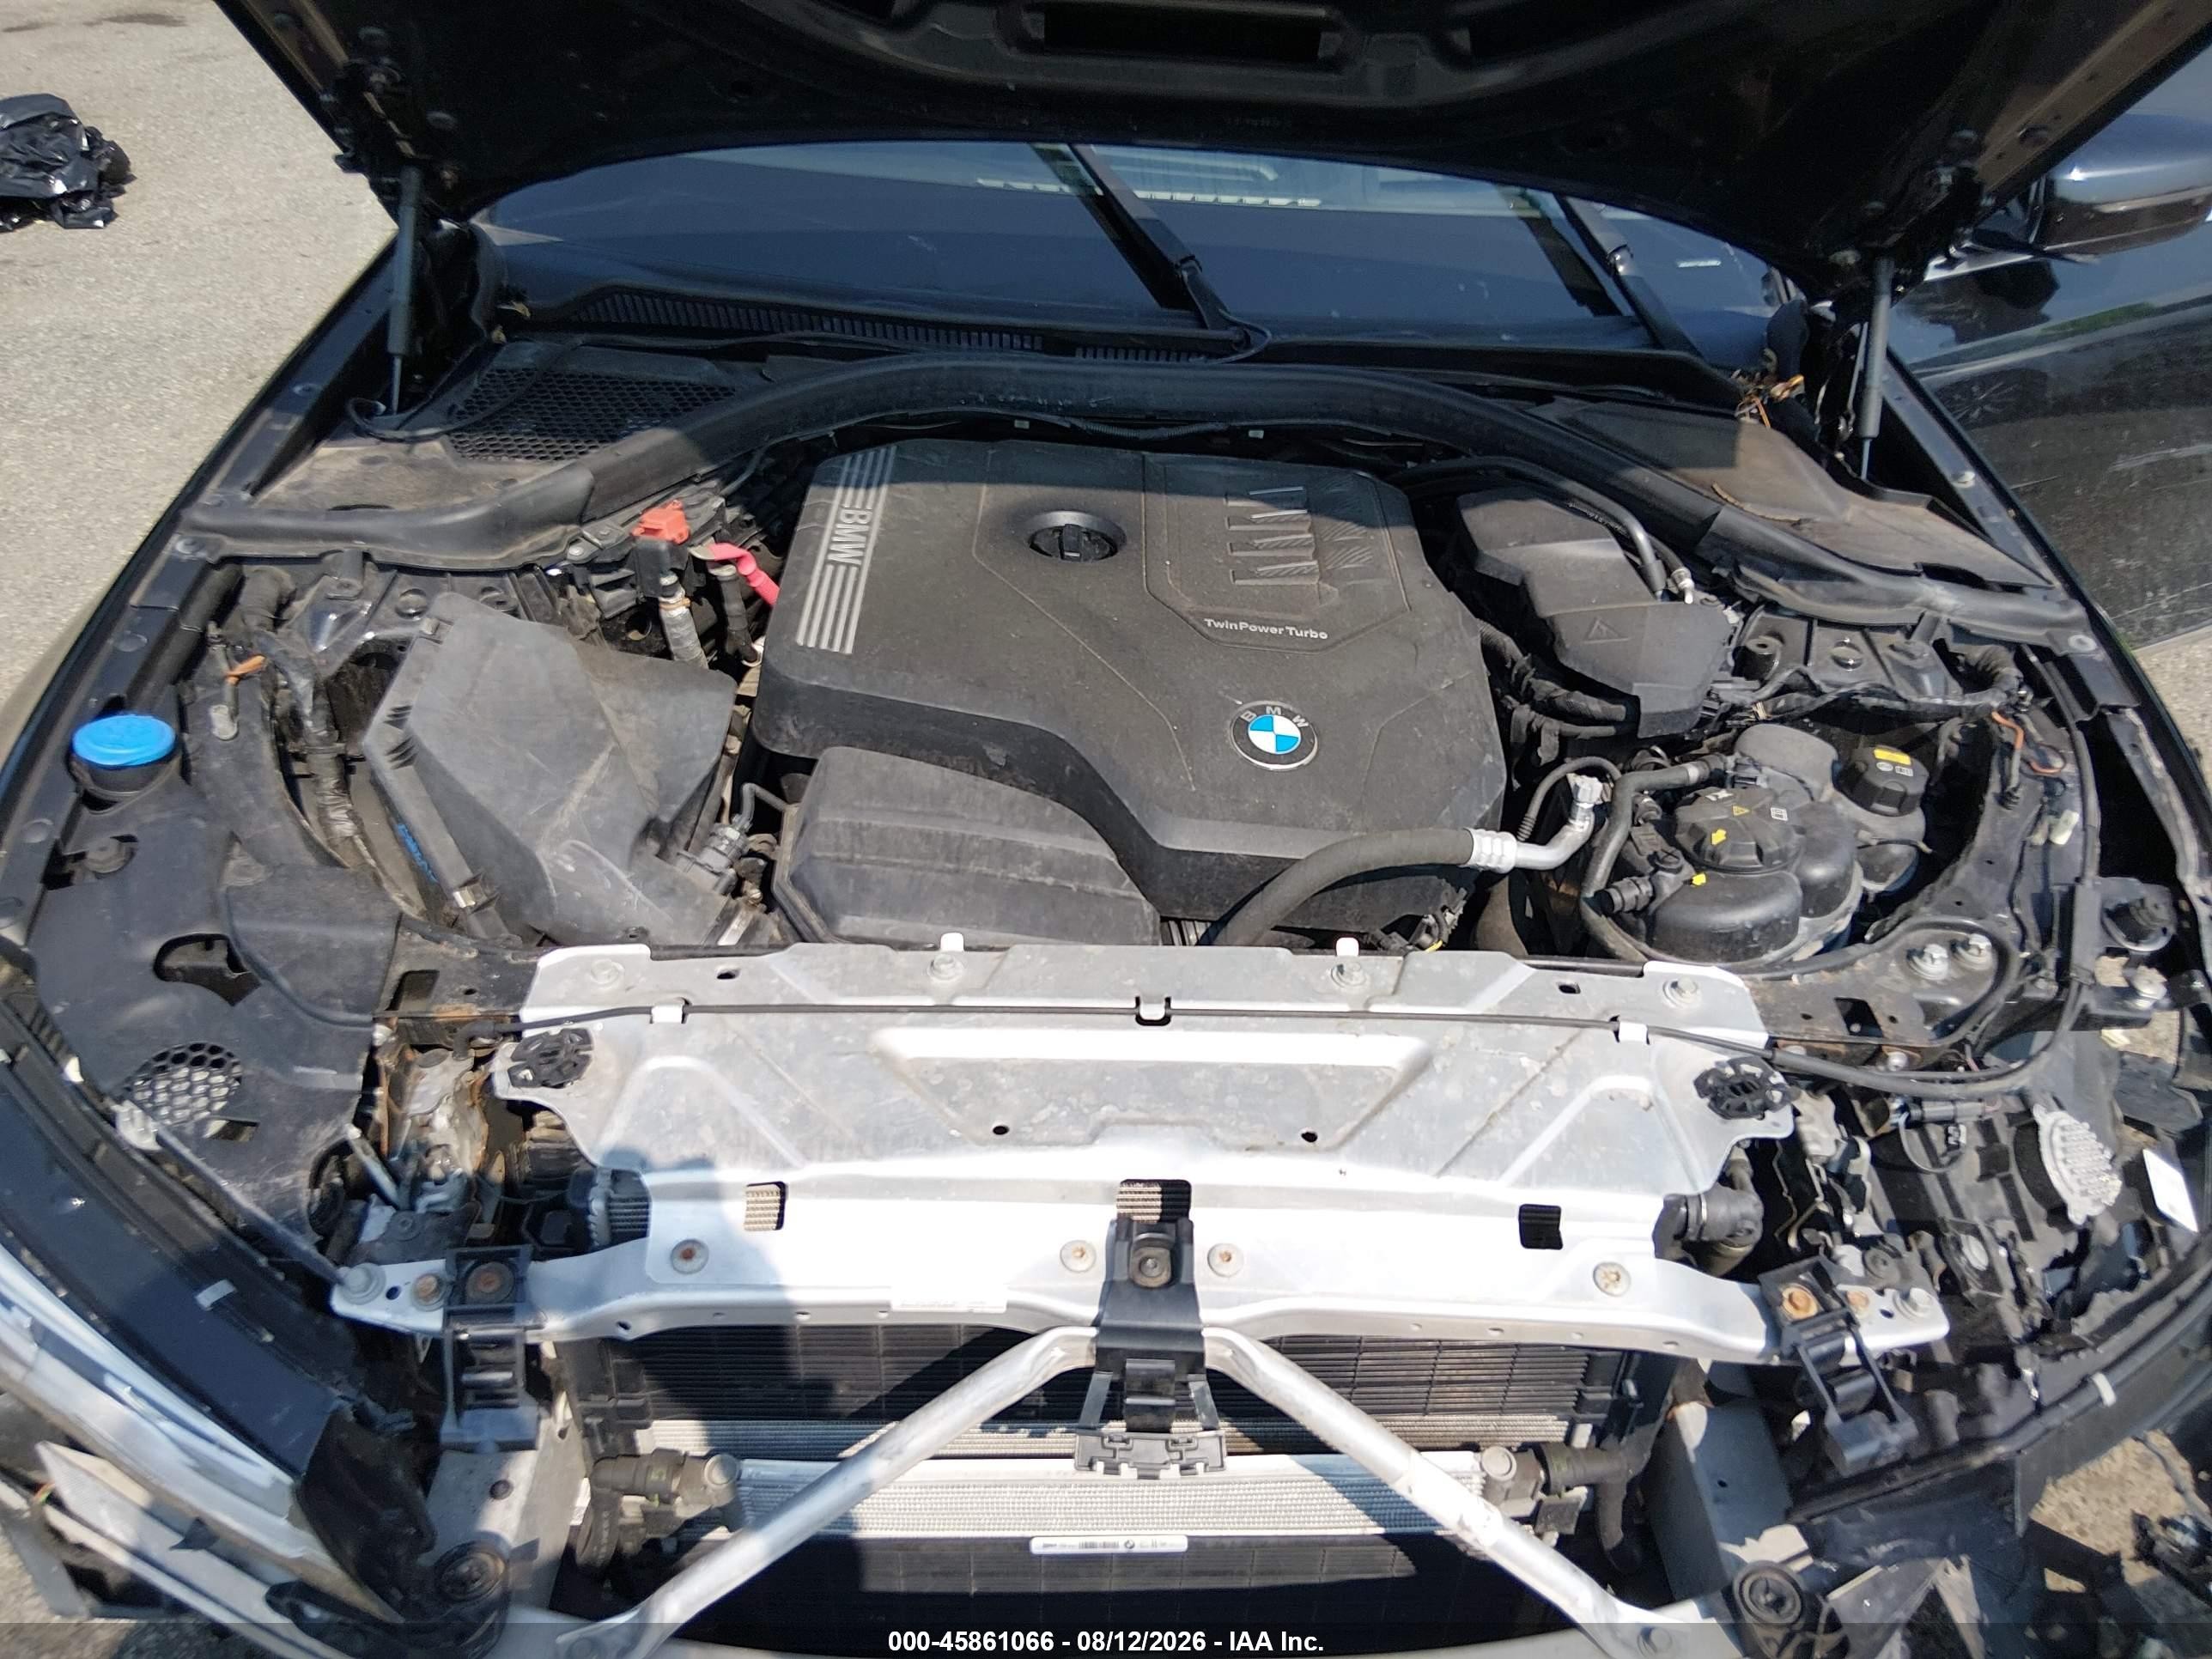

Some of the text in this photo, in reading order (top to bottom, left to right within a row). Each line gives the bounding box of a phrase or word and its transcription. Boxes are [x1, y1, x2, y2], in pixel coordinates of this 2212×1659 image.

[828, 509, 873, 565] BMW
[1204, 617, 1328, 640] TwinPower Turbo
[1240, 706, 1310, 728] BMW
